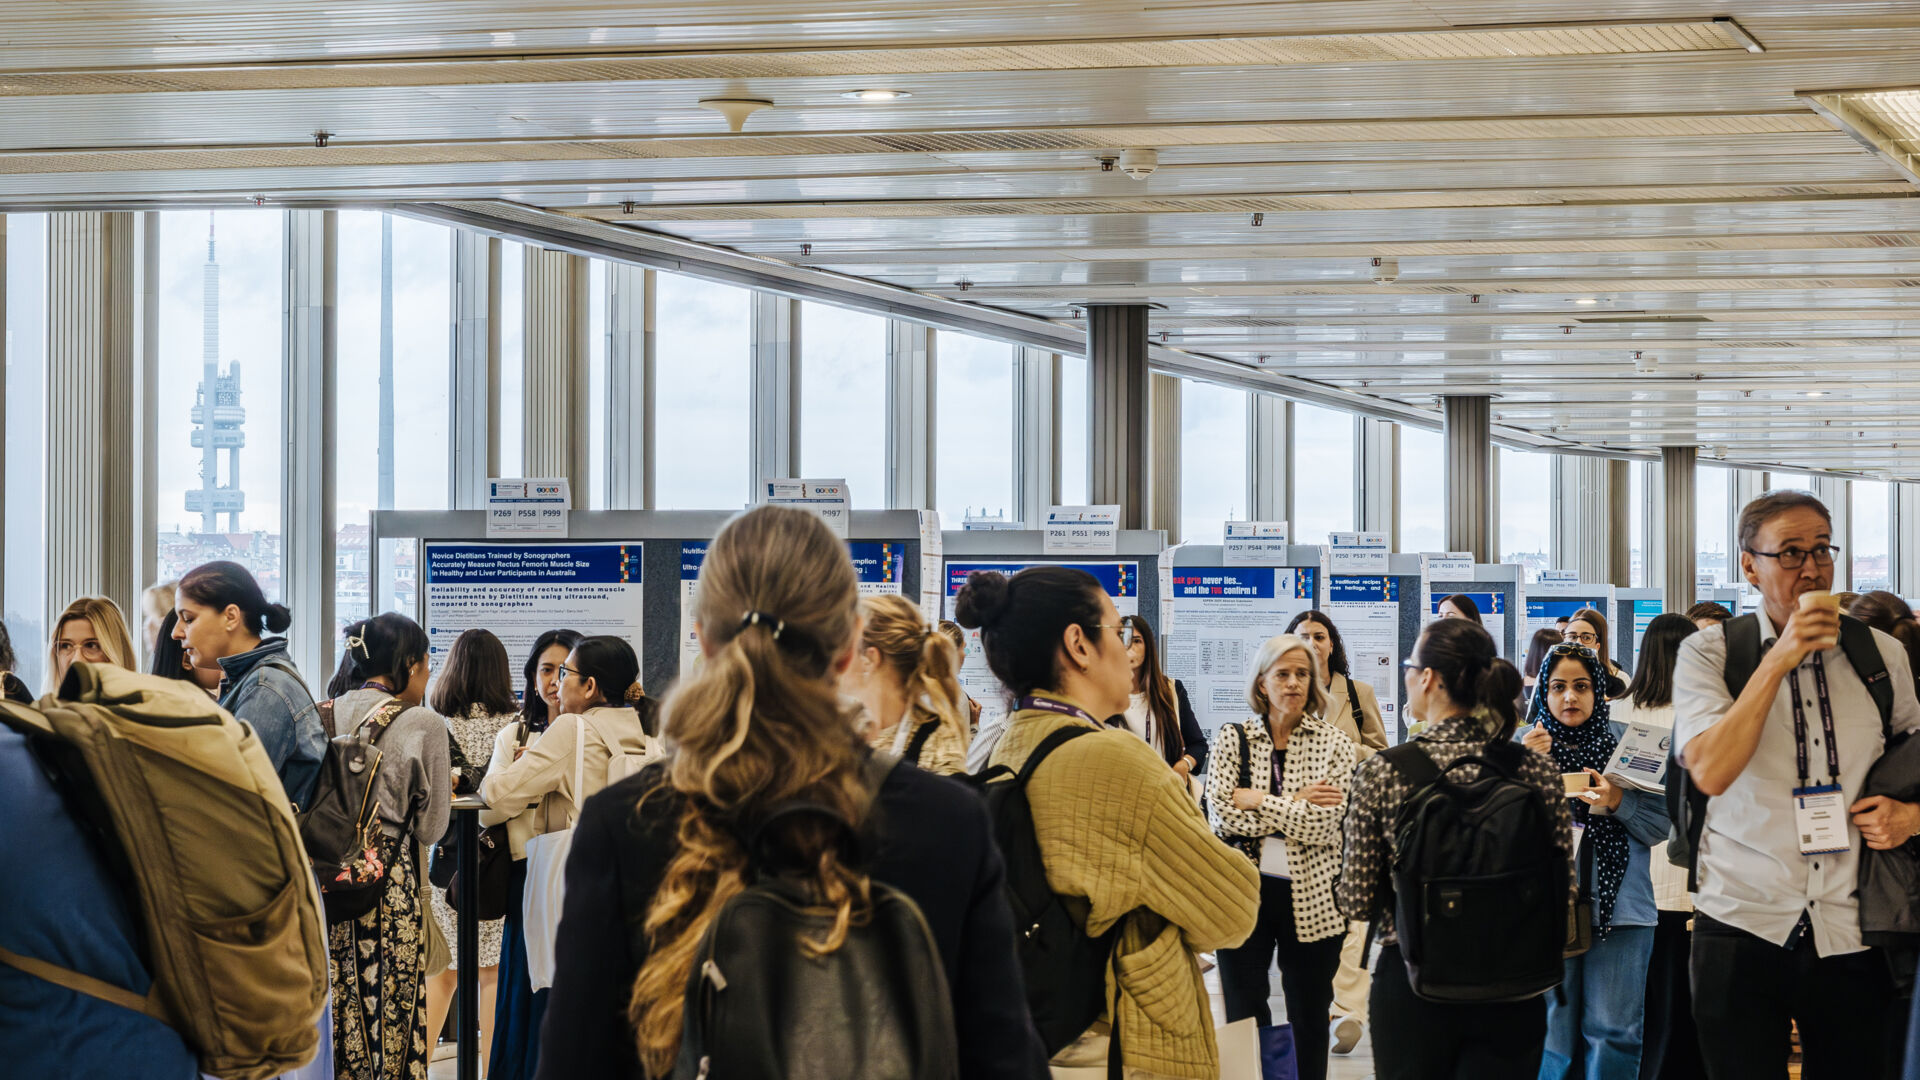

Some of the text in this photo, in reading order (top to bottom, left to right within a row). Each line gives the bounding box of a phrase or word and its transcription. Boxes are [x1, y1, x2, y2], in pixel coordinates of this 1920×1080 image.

[1187, 577, 1201, 585] grip
[1184, 586, 1197, 594] and
[1198, 586, 1209, 594] the
[1224, 586, 1250, 594] confirm
[1252, 586, 1257, 594] it
